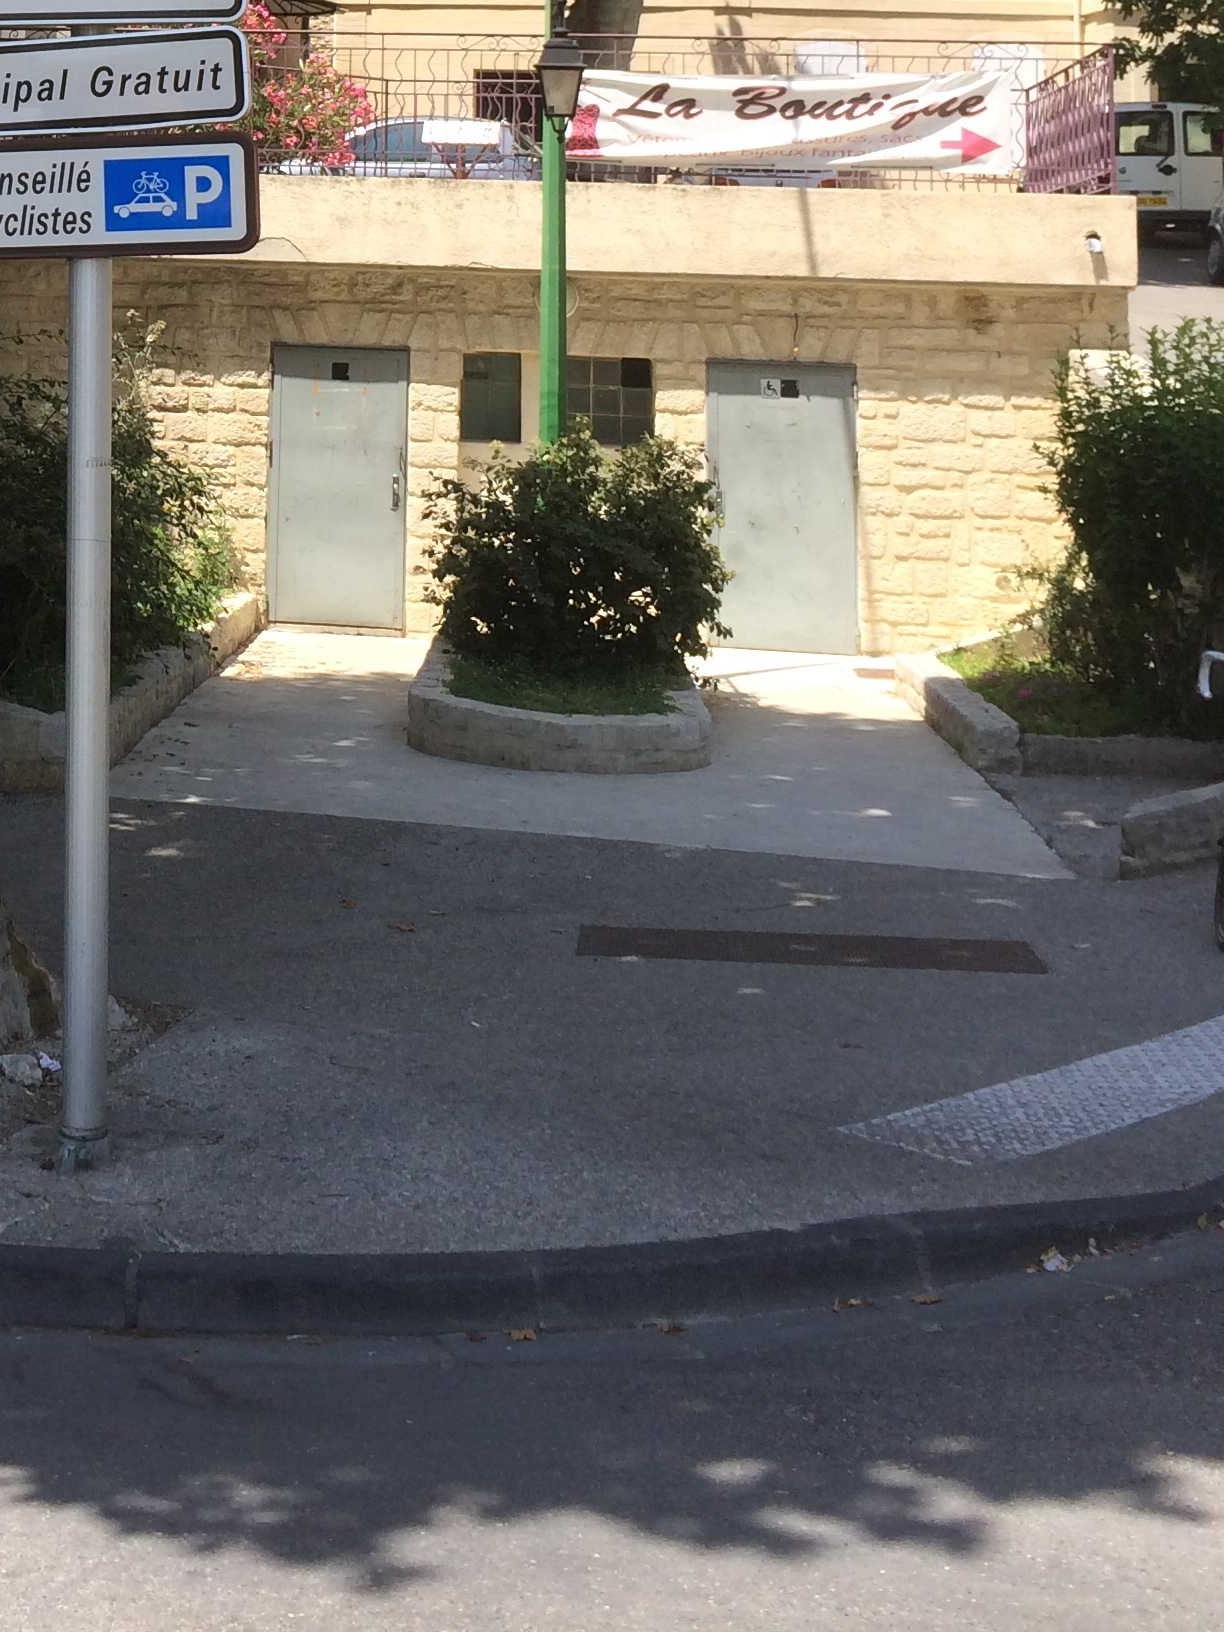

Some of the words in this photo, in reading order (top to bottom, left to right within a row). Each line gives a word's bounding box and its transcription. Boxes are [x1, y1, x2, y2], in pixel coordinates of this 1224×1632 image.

[90, 59, 223, 98] Gratuit
[612, 82, 703, 120] La
[732, 85, 988, 131] Boutique
[185, 165, 223, 220] P
